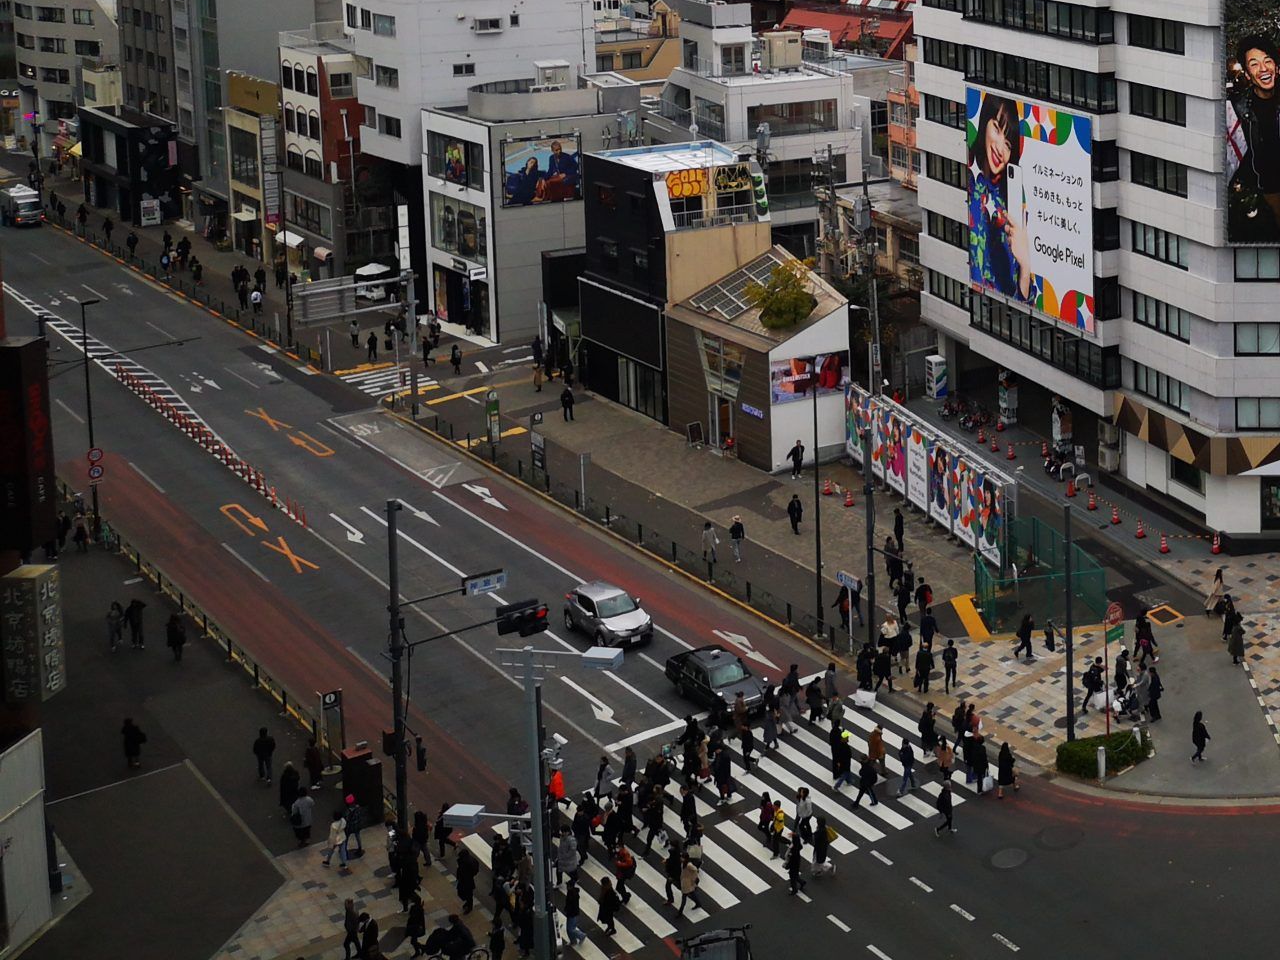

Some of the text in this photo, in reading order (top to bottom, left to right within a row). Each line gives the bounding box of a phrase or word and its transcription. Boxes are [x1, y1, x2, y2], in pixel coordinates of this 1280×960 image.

[1032, 163, 1083, 187] イルミネーションの
[1034, 236, 1085, 269] Google Pixel
